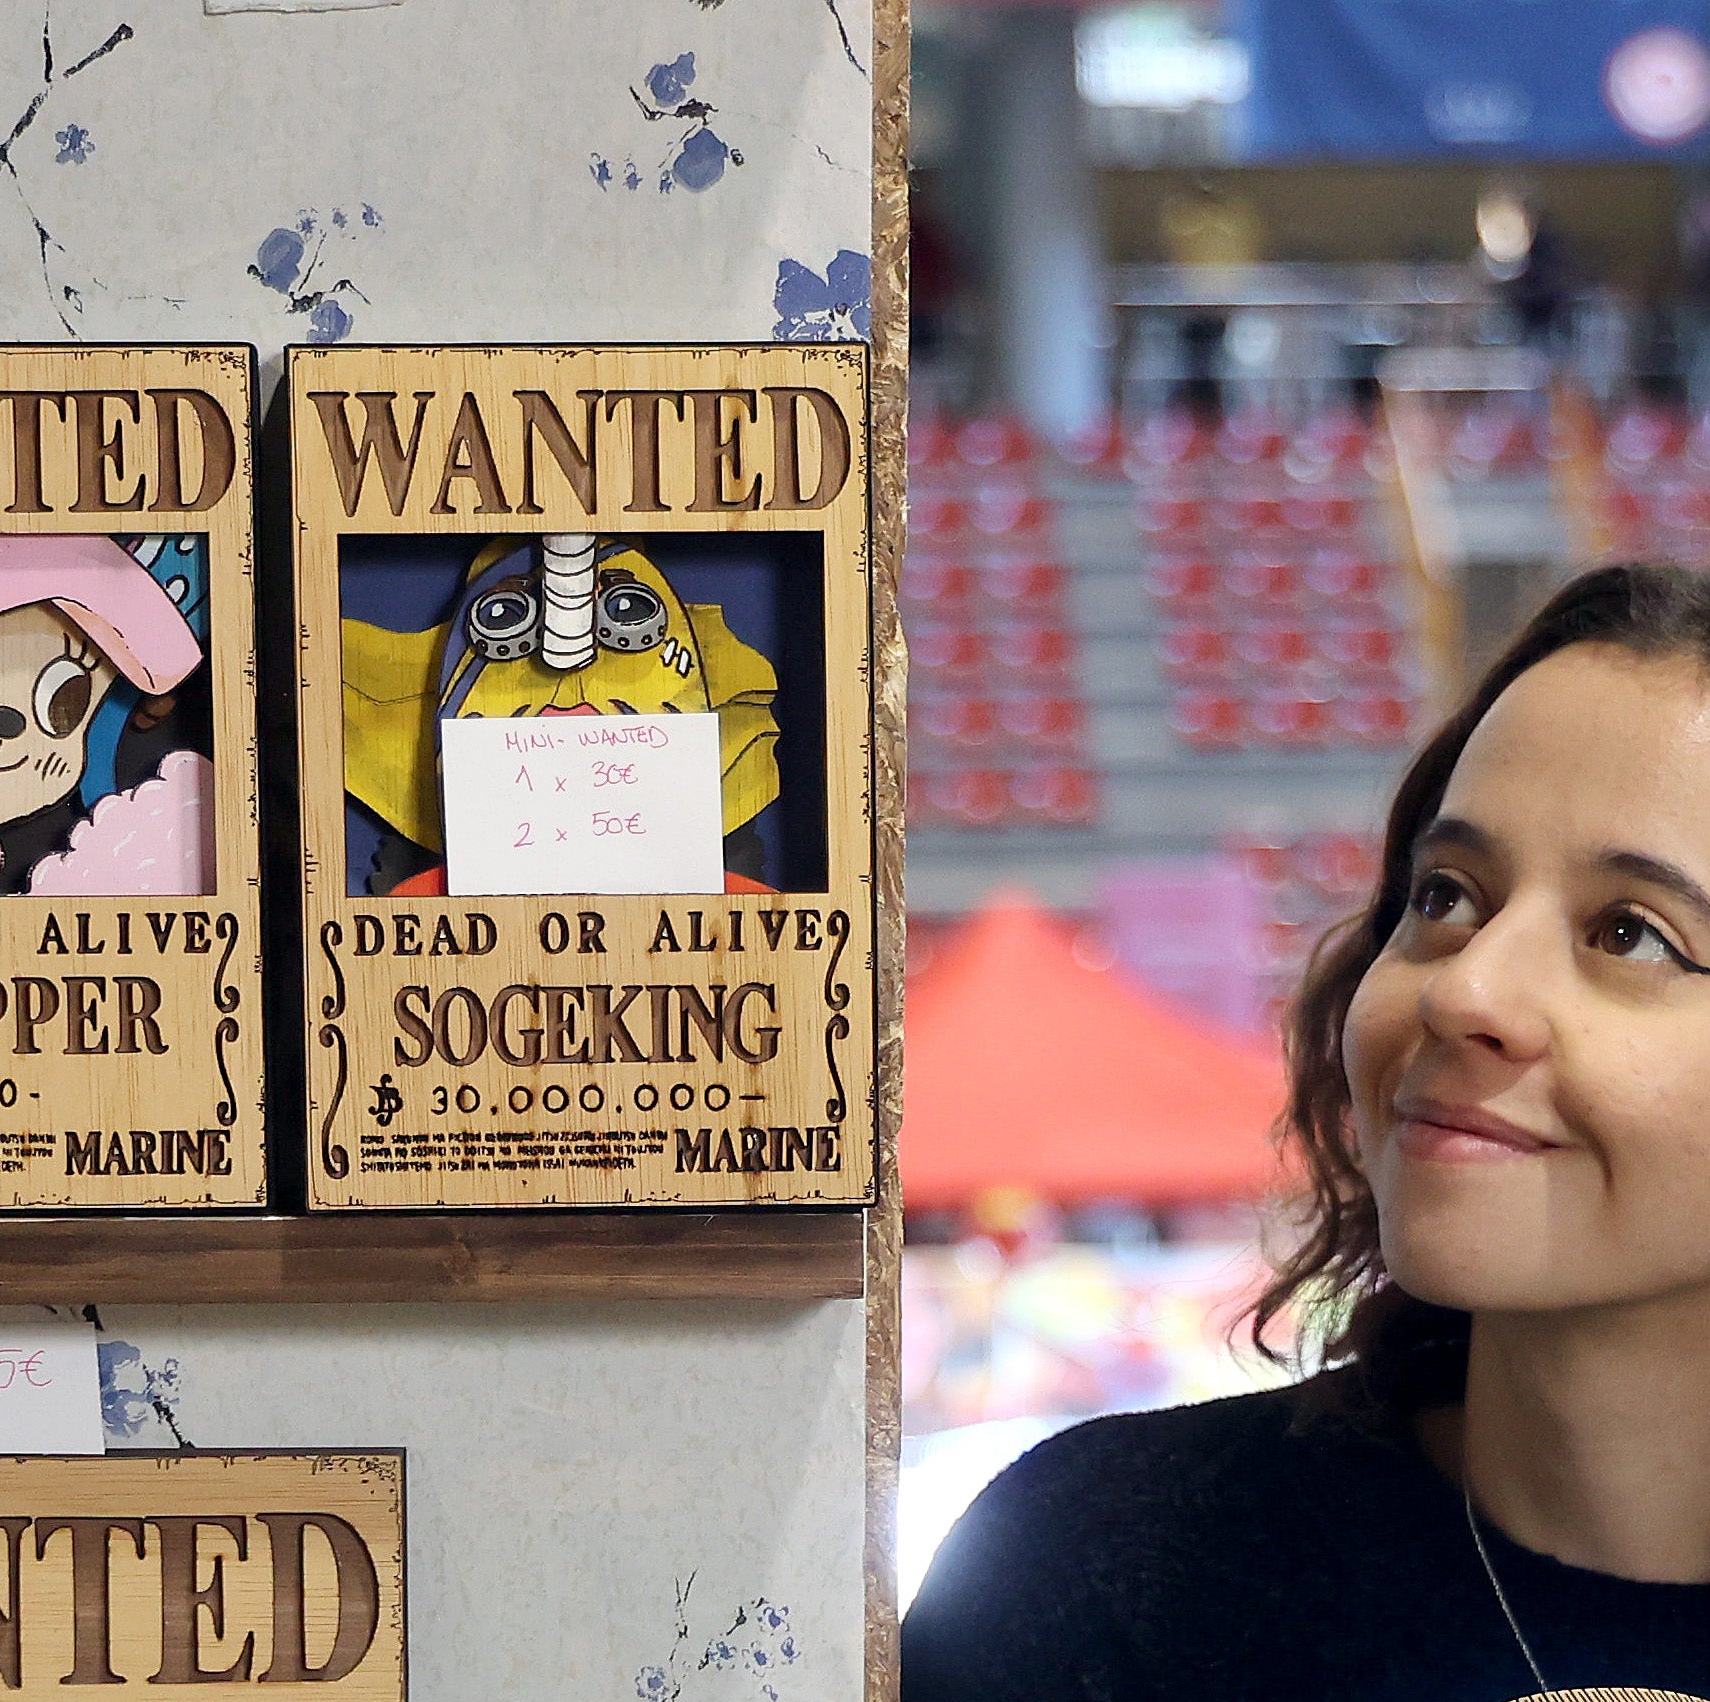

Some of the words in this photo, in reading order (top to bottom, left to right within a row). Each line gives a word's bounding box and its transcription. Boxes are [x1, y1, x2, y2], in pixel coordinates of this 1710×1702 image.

[306, 384, 852, 518] WANTED
[505, 731, 565, 753] MINI-
[578, 725, 670, 749] WANTED
[515, 765, 534, 792] 1
[591, 761, 639, 788] 30€
[513, 822, 536, 848] 2
[592, 810, 647, 837] 50€
[39, 911, 215, 957] ALIVE
[353, 913, 499, 959] DEAD
[539, 912, 607, 957] OR
[652, 909, 825, 956] ALIVE
[393, 981, 783, 1070] SOGEKING
[65, 1129, 233, 1178] MARINE
[675, 1127, 842, 1176] MARINE
